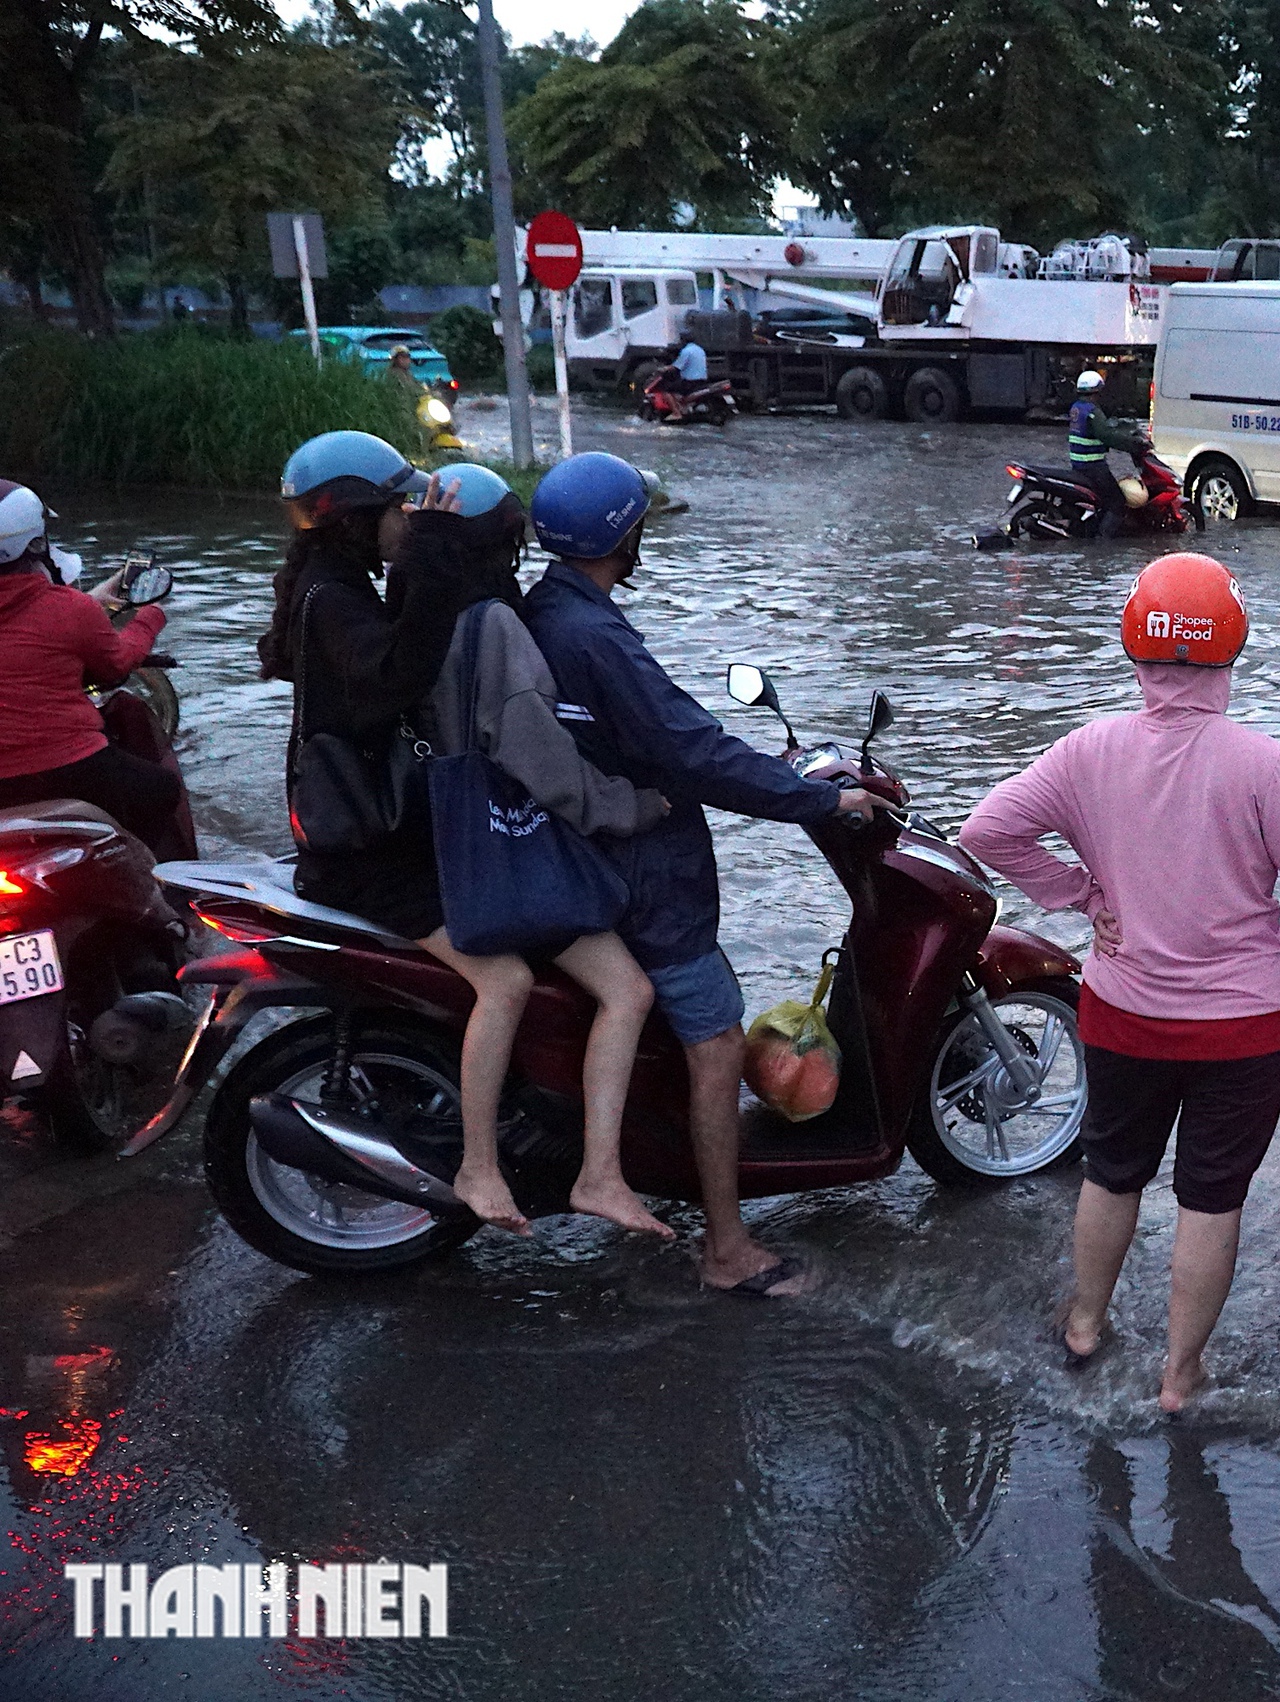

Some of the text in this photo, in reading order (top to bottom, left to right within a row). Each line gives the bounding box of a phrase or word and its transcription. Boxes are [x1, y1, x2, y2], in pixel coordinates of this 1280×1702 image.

[1173, 612, 1213, 628] Shopee
[1172, 624, 1213, 640] Food
[0, 962, 57, 997] 5.90
